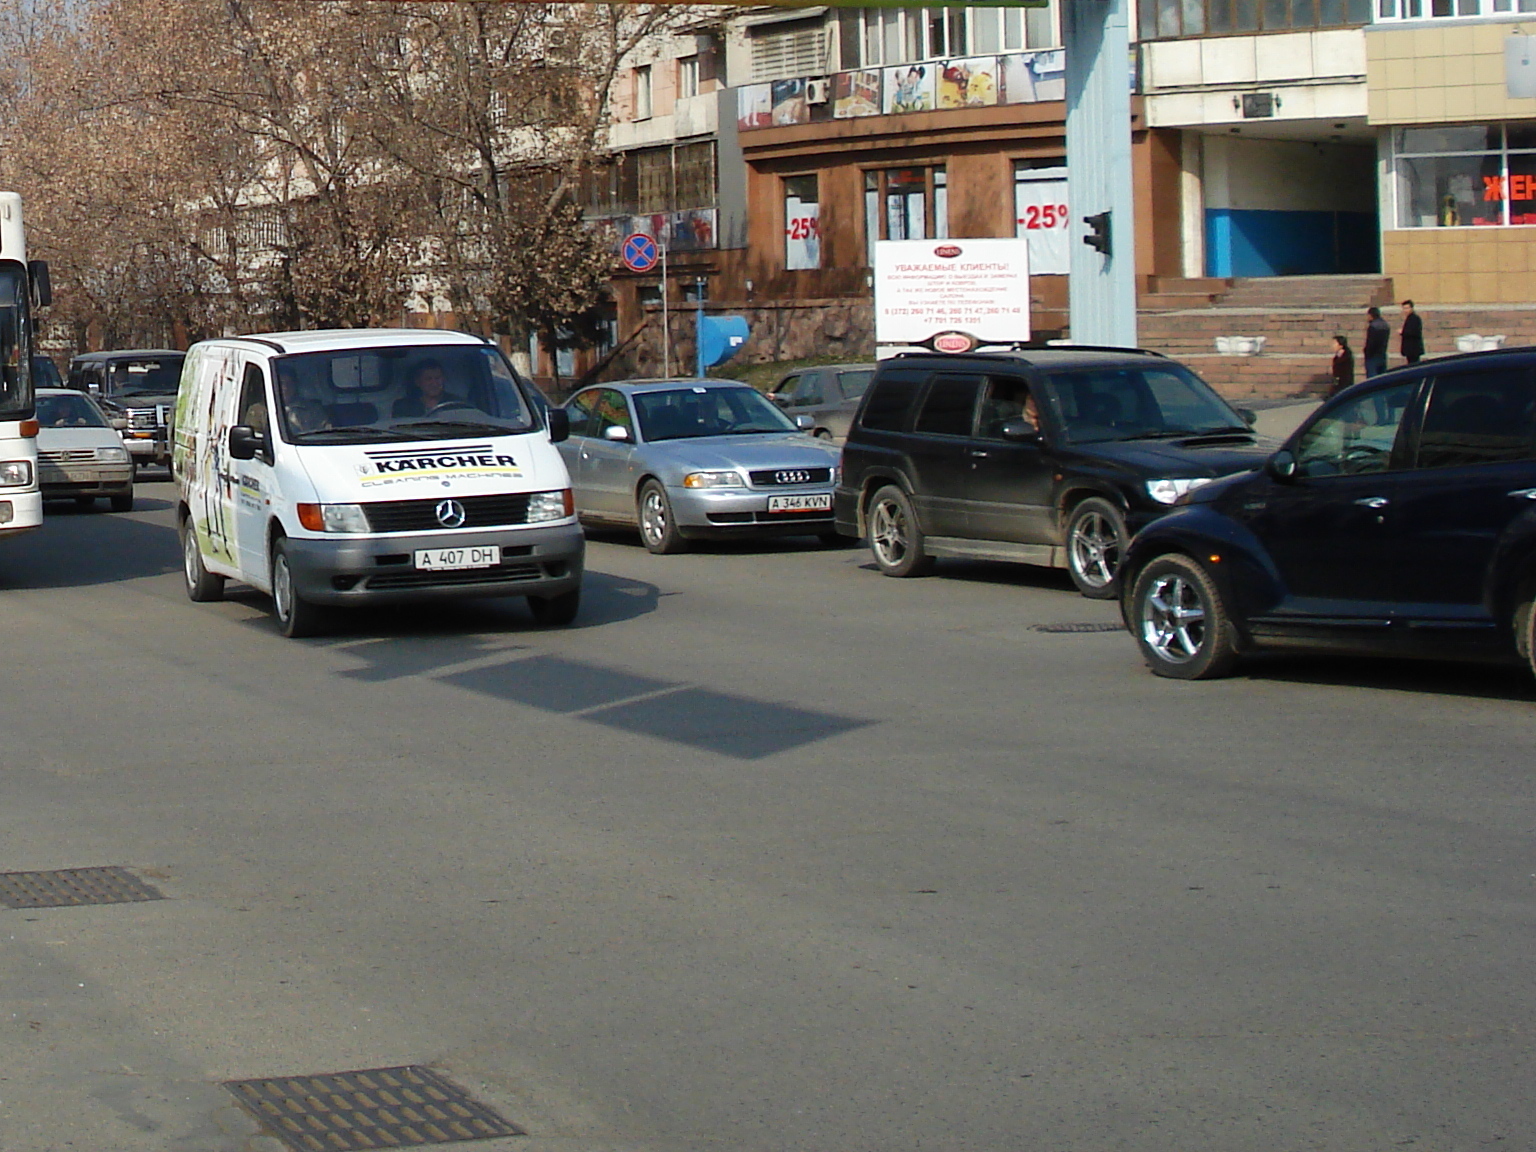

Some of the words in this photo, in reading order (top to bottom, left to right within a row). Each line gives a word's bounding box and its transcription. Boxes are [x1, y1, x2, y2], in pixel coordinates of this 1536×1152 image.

[894, 264, 956, 272] УВАЖАЕМЫЕ
[960, 263, 1009, 272] КЛИЕНТЫ!
[375, 455, 517, 473] KÄRCHER
[422, 552, 432, 566] A
[439, 550, 464, 564] 407
[471, 549, 493, 563] DH
